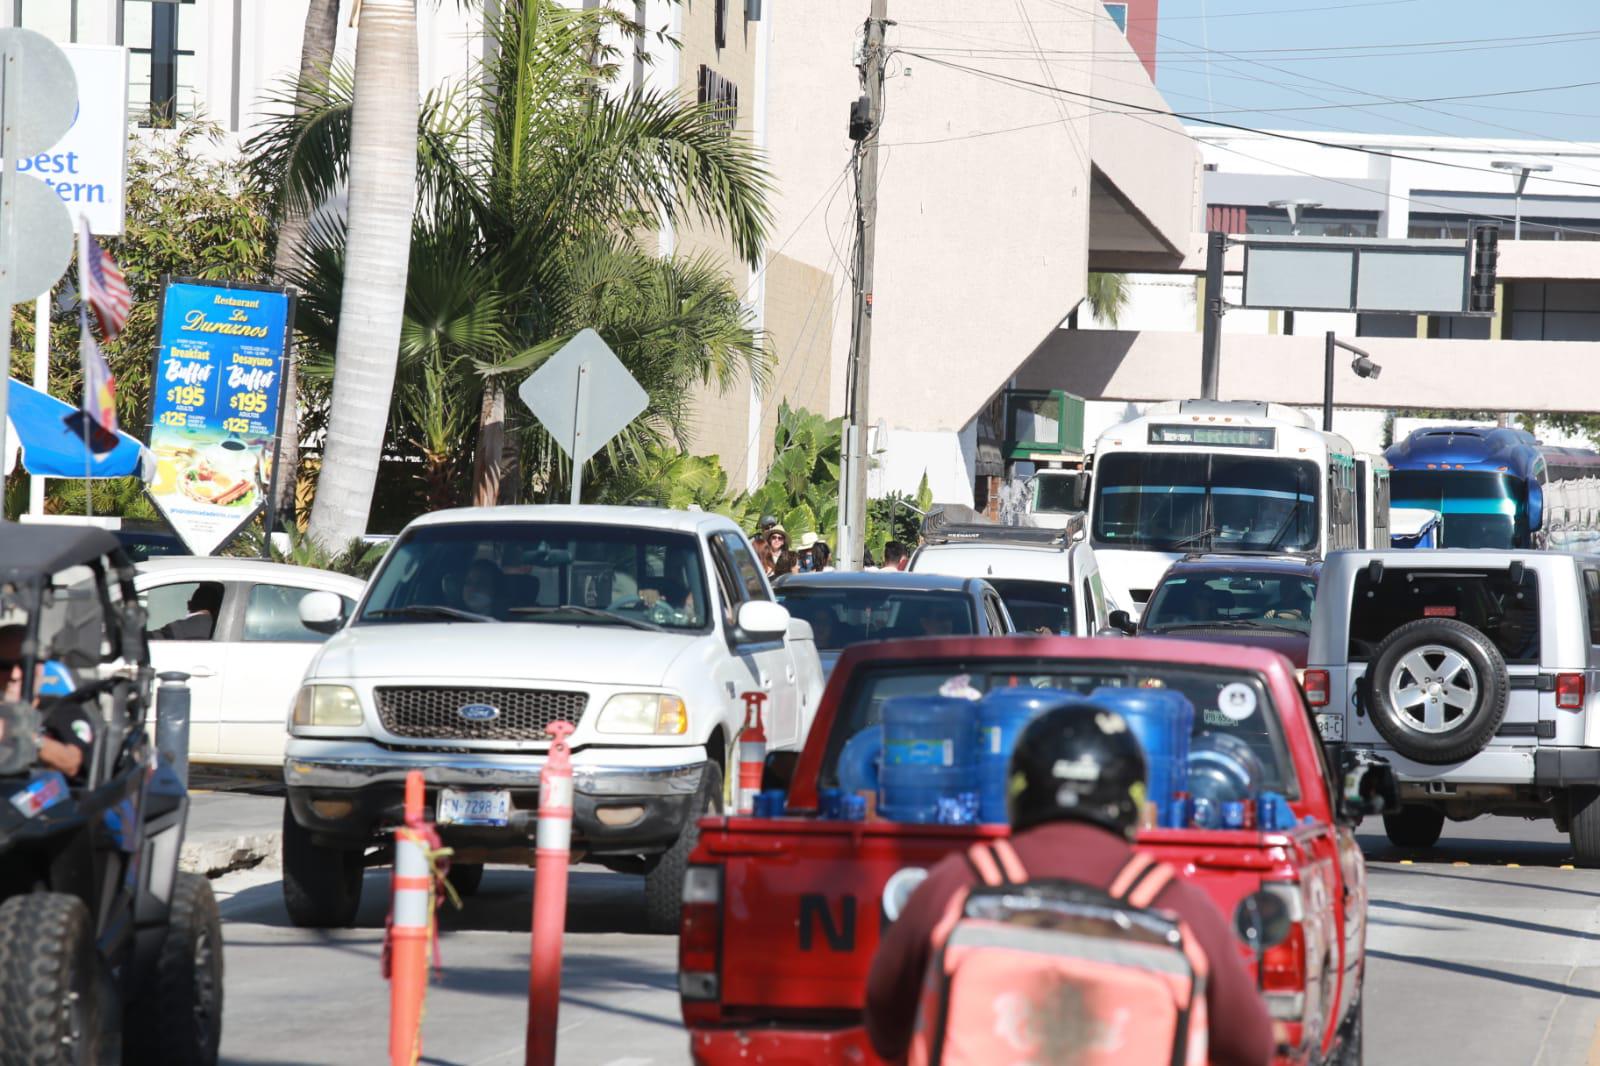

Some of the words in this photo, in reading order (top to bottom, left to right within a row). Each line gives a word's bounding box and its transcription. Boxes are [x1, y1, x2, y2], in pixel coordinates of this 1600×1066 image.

[213, 294, 259, 308] Restaurant
[181, 310, 268, 337] Duraznos
[170, 347, 210, 361] Breakfast
[232, 353, 273, 367] Desayuno
[163, 358, 215, 385] Buffet
[226, 364, 277, 390] Buffet
[166, 386, 205, 407] $195
[229, 392, 268, 413] $195
[160, 411, 187, 427] $125
[223, 417, 249, 433] $125
